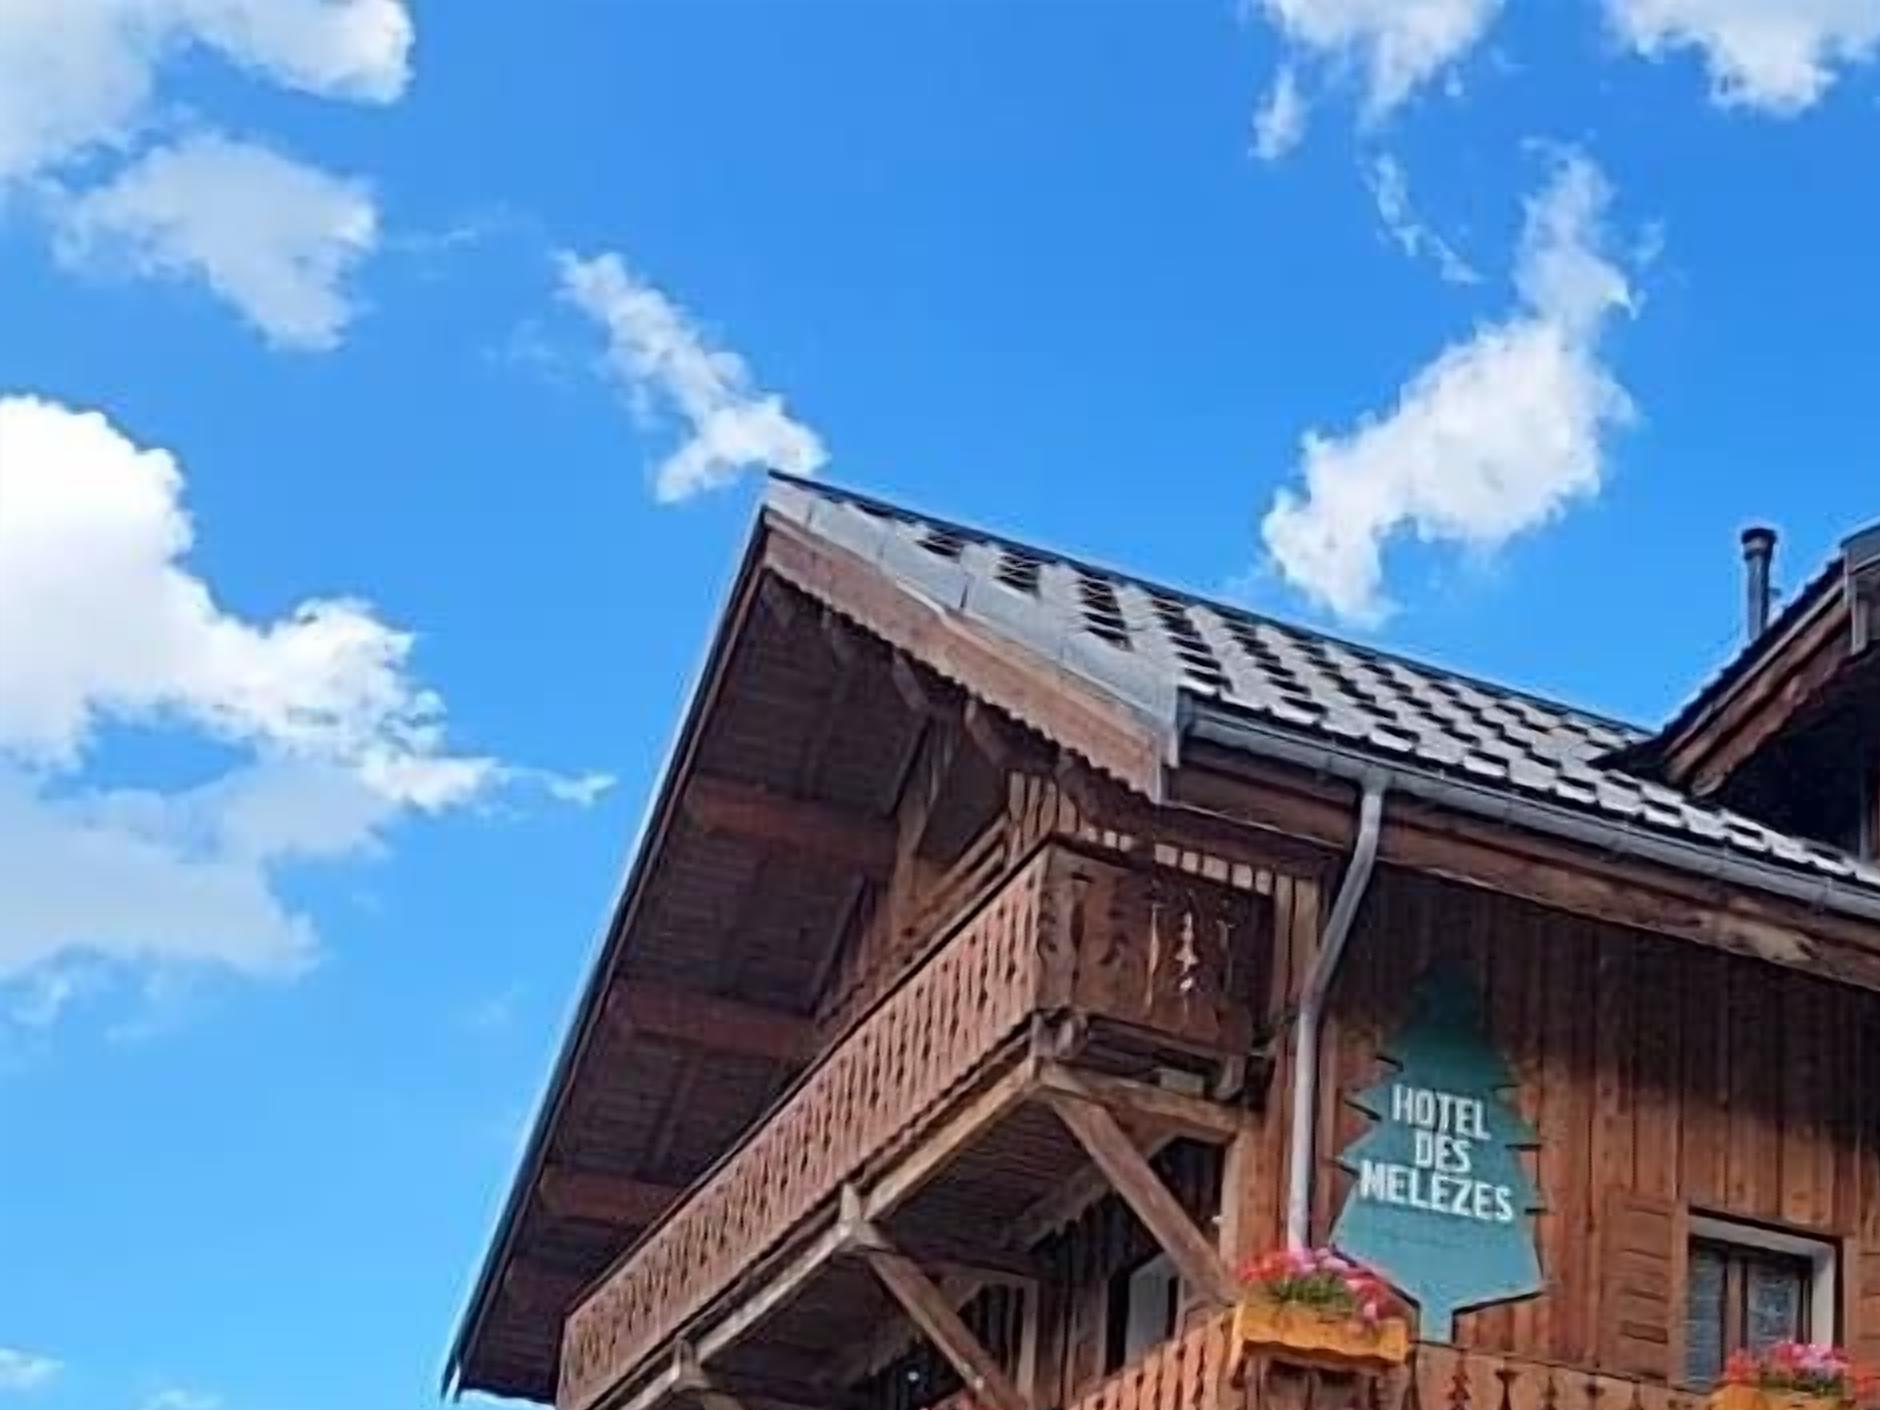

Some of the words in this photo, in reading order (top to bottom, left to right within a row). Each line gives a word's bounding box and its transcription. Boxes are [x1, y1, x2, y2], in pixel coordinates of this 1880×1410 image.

[1391, 1083, 1492, 1141] HOTEL
[1414, 1131, 1472, 1173] DES
[1359, 1159, 1513, 1222] MELEZES
